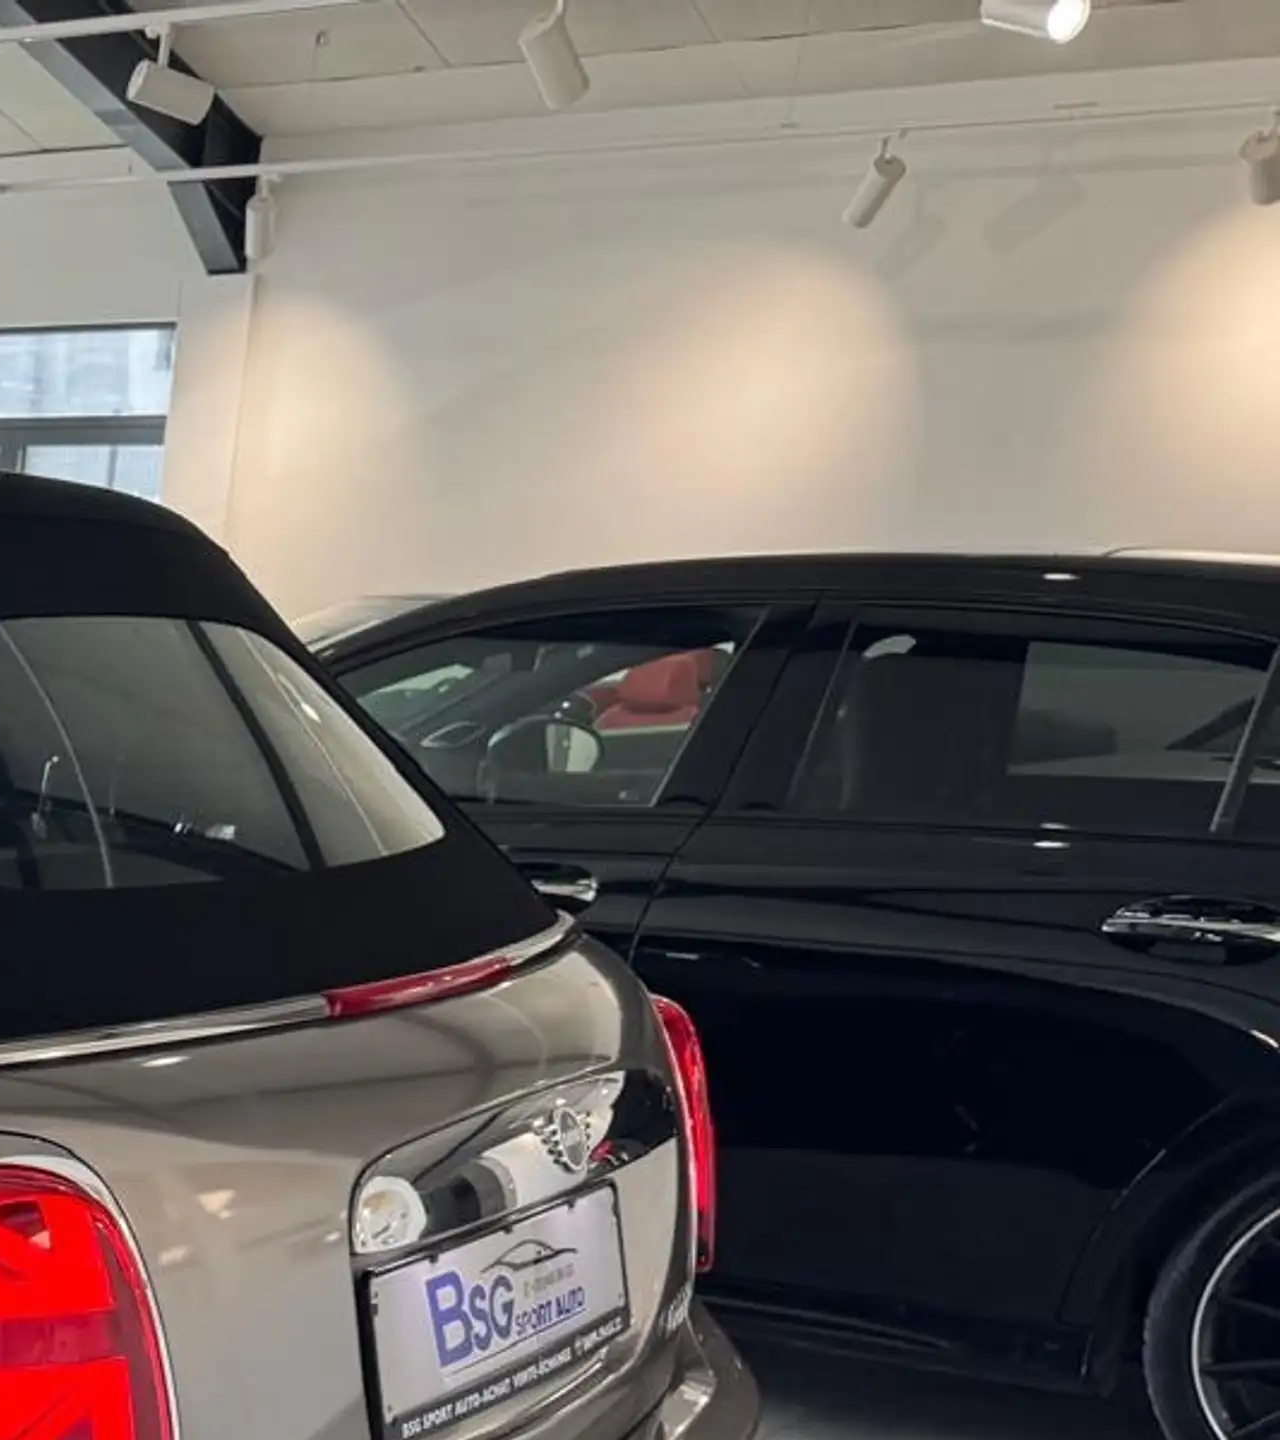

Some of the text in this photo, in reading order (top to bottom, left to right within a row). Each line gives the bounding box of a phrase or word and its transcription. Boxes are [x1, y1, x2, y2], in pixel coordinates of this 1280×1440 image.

[515, 1300, 552, 1336] SPORT
[555, 1286, 585, 1318] AUTO
[422, 1403, 453, 1433] SPORT
